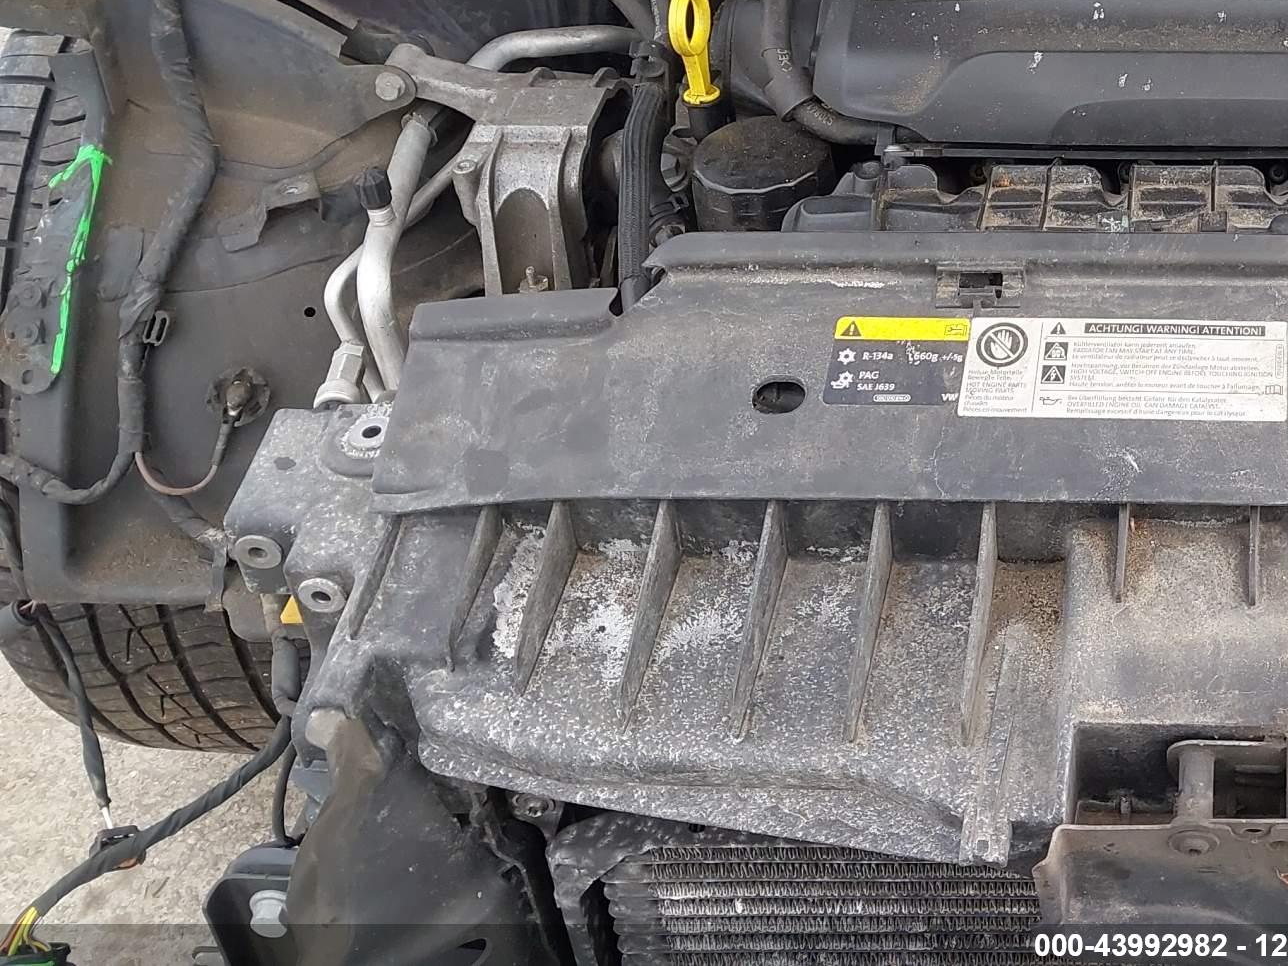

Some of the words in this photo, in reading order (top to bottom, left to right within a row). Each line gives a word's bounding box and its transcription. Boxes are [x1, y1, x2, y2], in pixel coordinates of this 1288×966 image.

[1088, 324, 1144, 334] ACHTUNG!
[1146, 324, 1200, 335] WARNING!
[1200, 325, 1262, 335] ATTENTION!
[863, 351, 895, 361] R-134a
[859, 370, 880, 380] PAG
[857, 383, 875, 391] SAE
